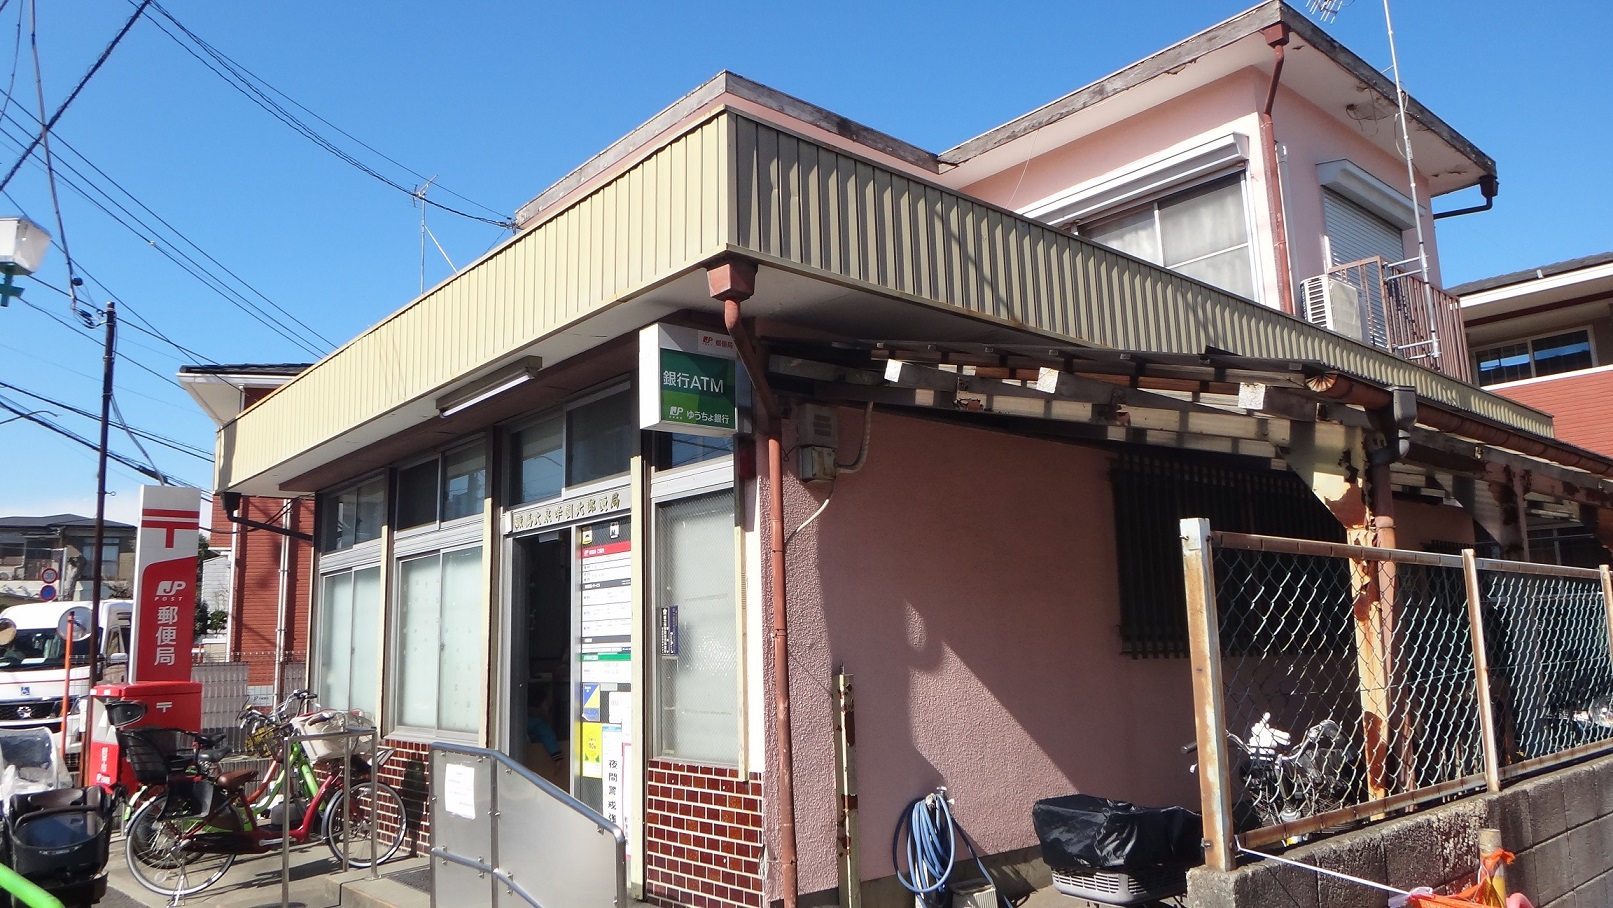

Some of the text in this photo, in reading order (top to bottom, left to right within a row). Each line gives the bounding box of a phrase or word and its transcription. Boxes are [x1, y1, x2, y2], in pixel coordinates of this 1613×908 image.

[663, 370, 724, 393] 銀行ATM
[686, 410, 729, 424] ゆうちょ銀行
[154, 606, 178, 666] 郵便局
